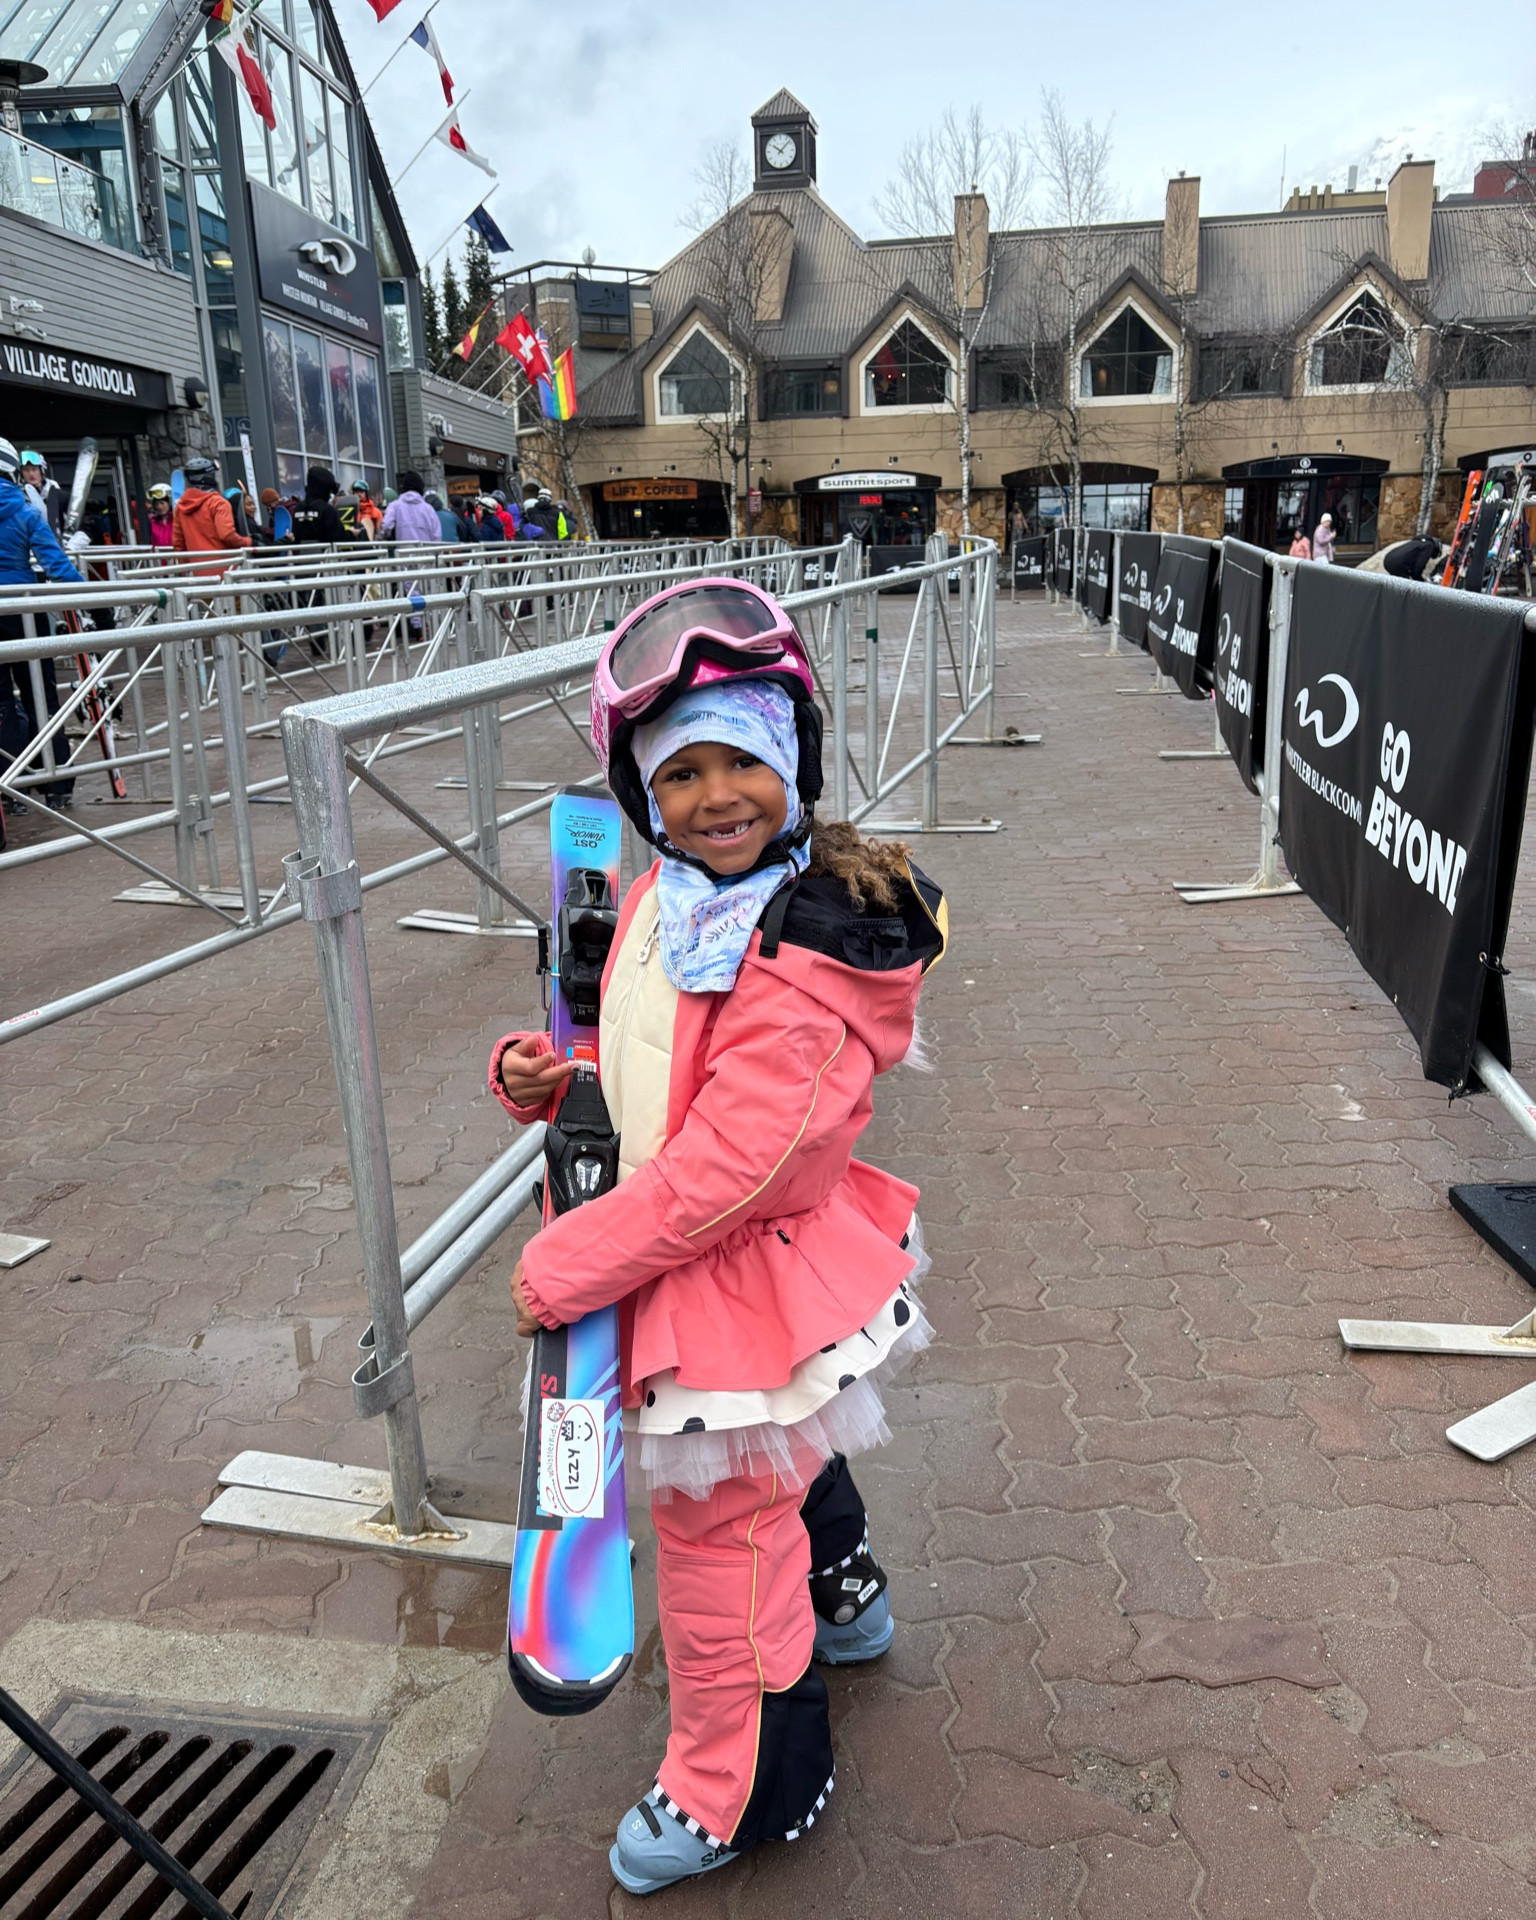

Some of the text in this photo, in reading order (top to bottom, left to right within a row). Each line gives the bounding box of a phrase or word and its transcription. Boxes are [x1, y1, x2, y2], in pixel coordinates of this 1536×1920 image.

[3, 344, 137, 397] VILLAGE GONDOLA
[612, 484, 689, 497] LIFT COFFEE
[823, 477, 911, 487] summitsport
[1230, 633, 1241, 670] GO
[1381, 721, 1411, 793] GO
[573, 839, 598, 849] QST
[565, 1448, 580, 1490] Izzy
